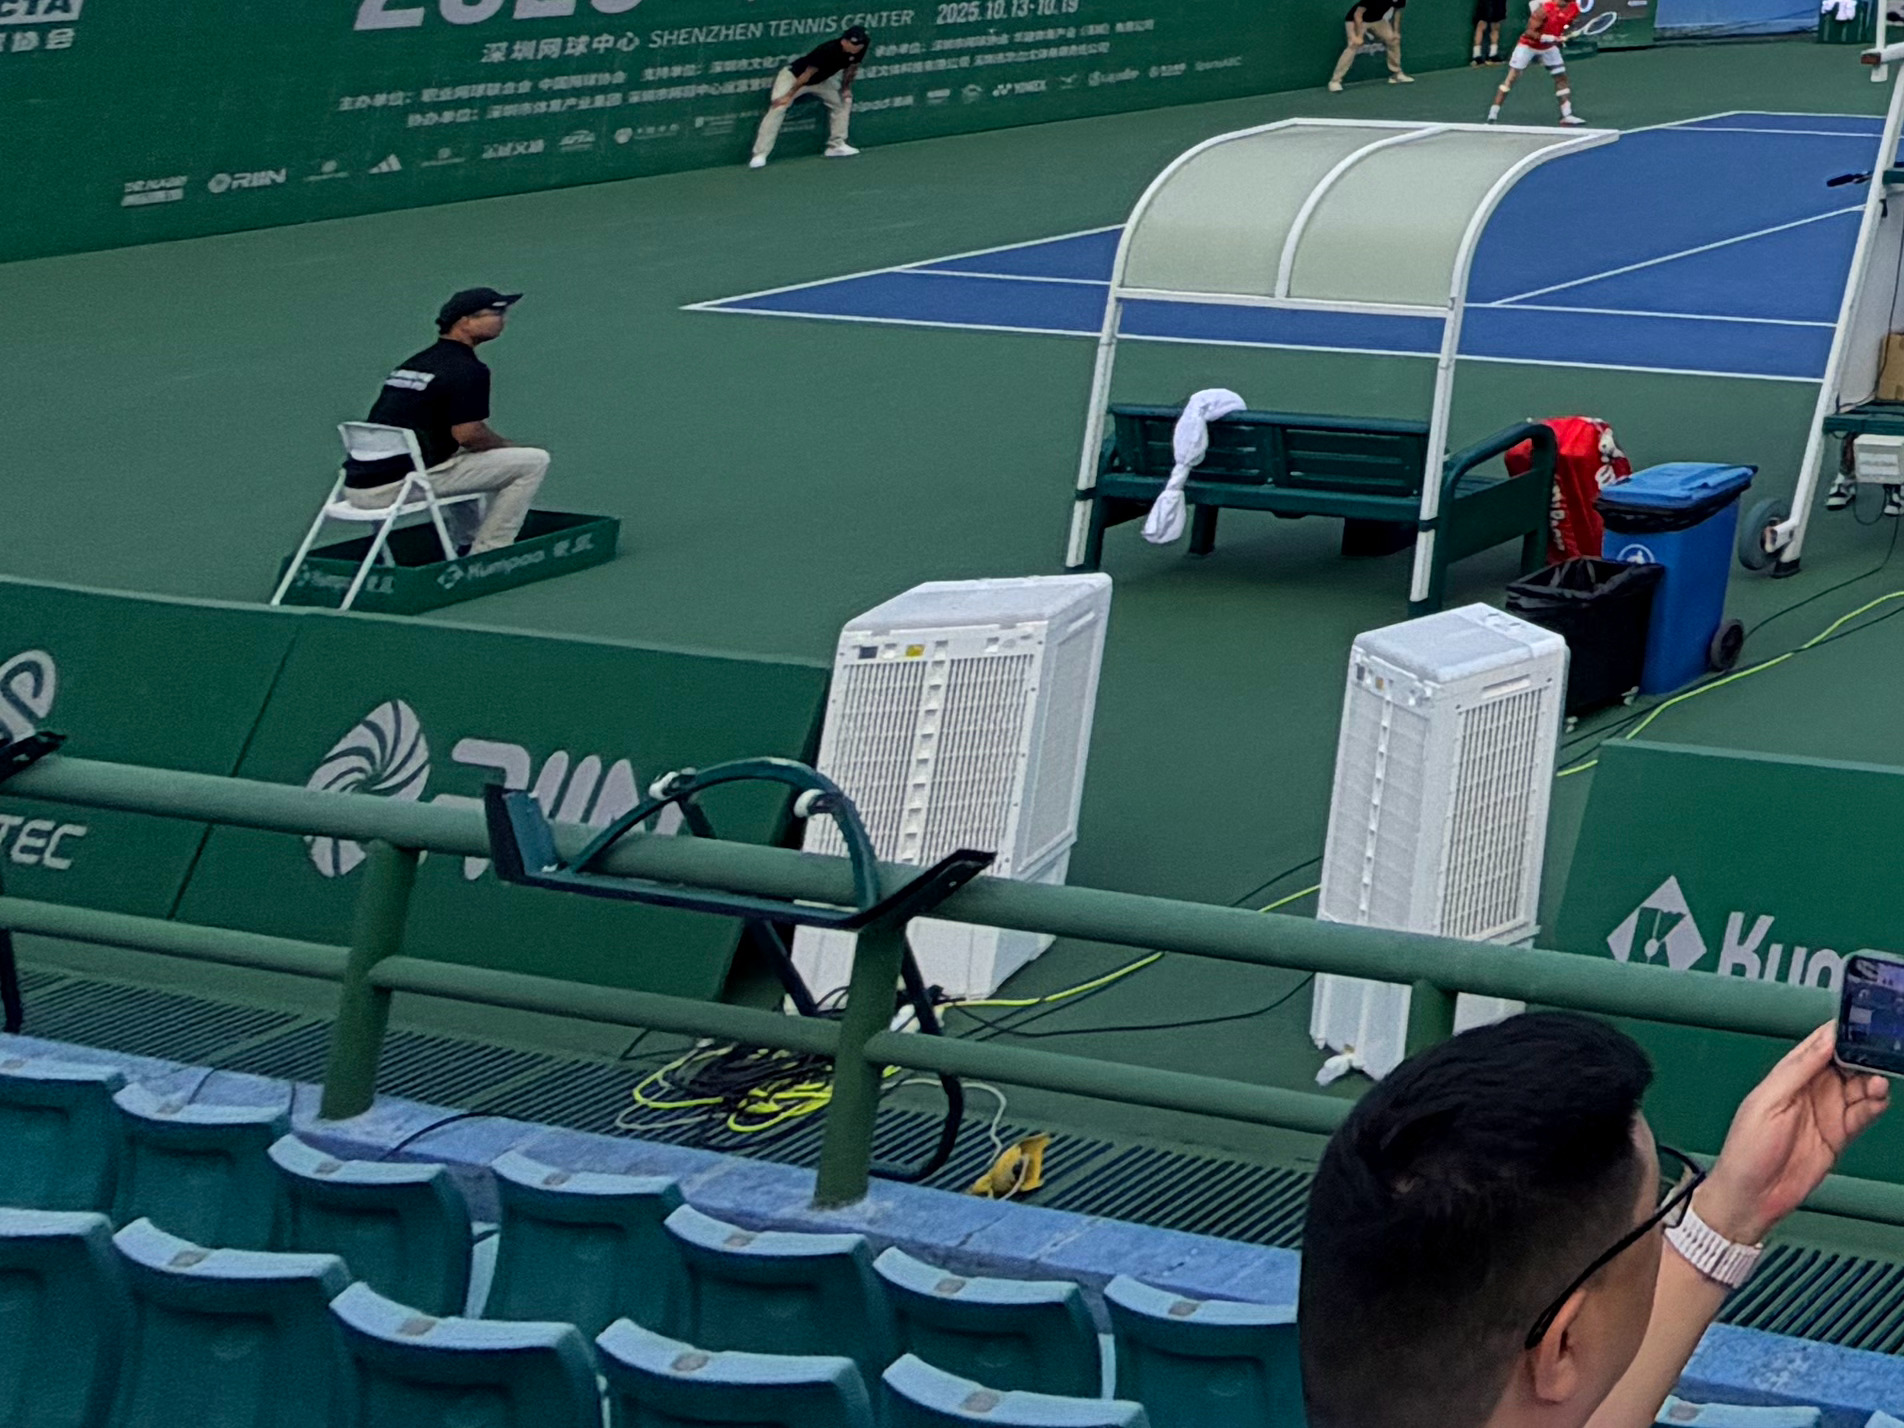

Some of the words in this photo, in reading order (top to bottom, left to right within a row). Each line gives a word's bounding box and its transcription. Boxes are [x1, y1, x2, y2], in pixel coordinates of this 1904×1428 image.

[480, 31, 641, 63] 深圳网球中心
[648, 21, 763, 49] SHENZHEN
[769, 15, 839, 38] TENNIS
